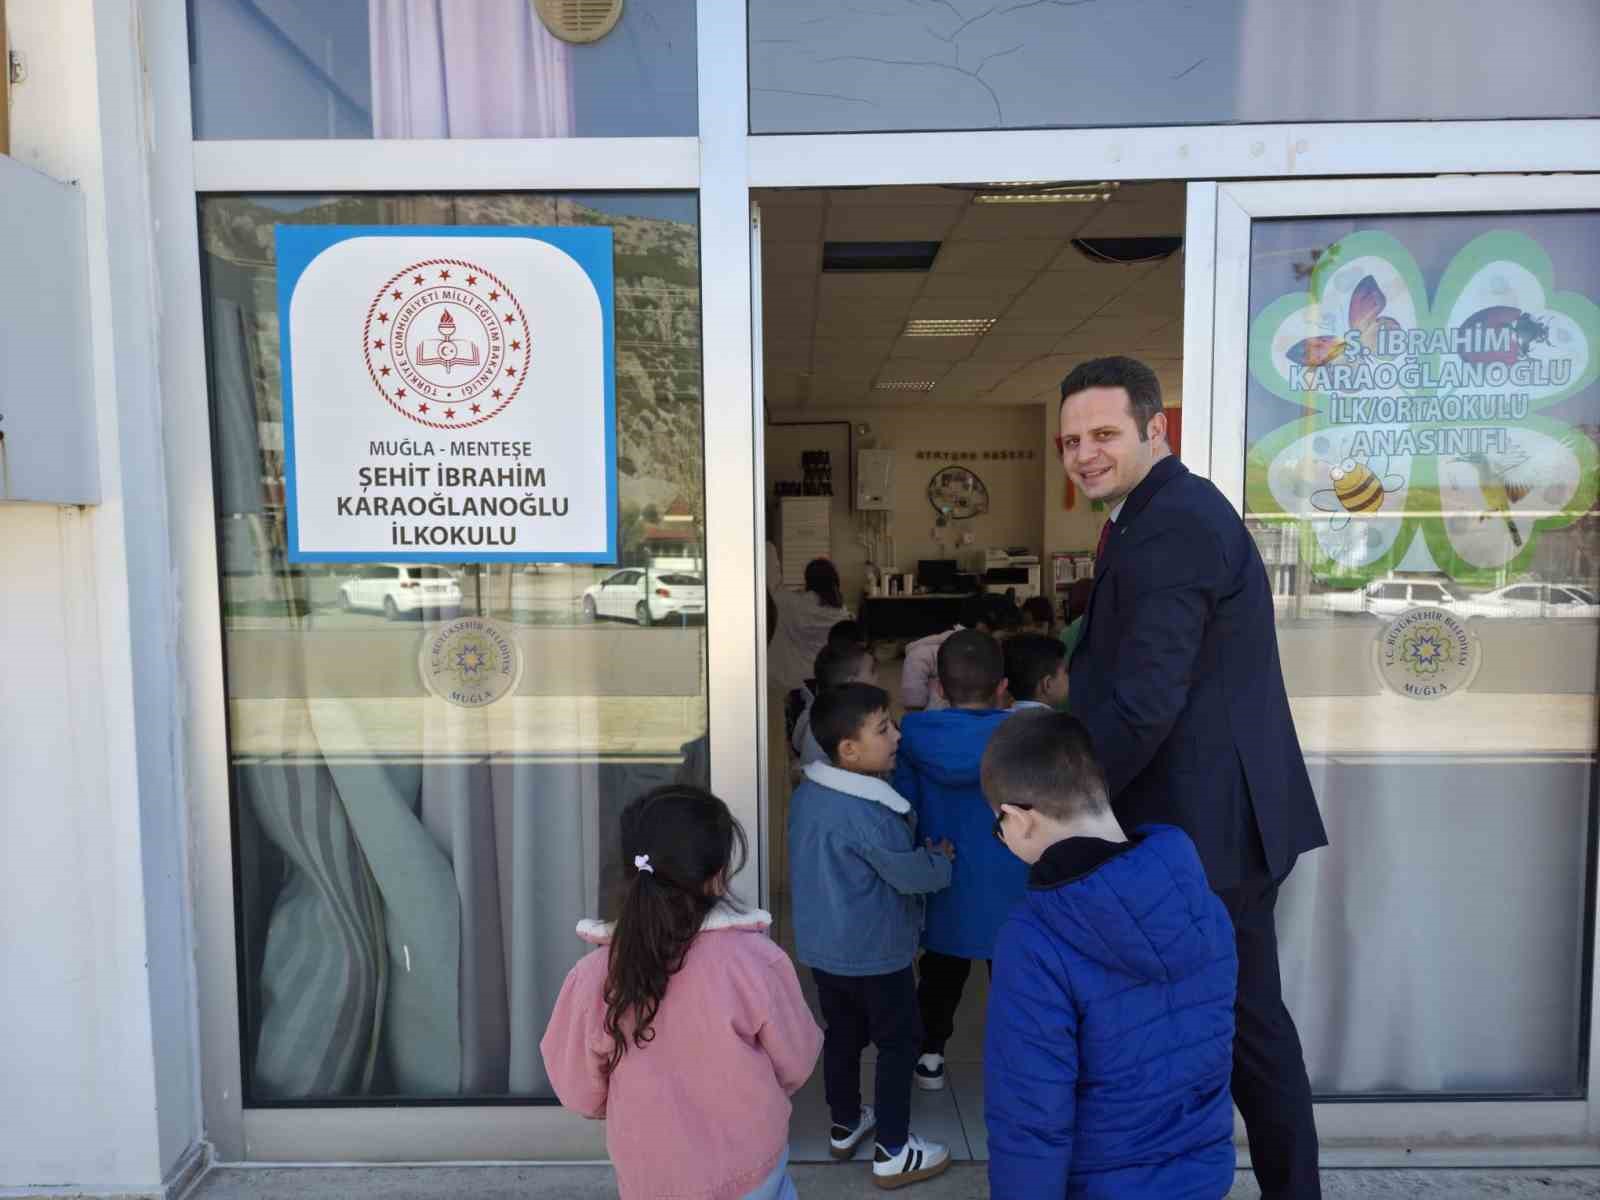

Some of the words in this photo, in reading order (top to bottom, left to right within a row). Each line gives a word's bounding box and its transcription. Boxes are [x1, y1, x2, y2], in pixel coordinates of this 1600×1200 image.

[394, 289, 439, 358] CUMHURİYETİ
[474, 304, 500, 343] EĞİTİM
[1343, 330, 1371, 363] Ş.
[1376, 326, 1511, 355] İBRAHİM
[399, 359, 437, 398] TÜRKİYE
[461, 345, 501, 397] BAKANLIĞI
[1288, 355, 1572, 391] KARAOĞLANOĞLU
[1329, 393, 1529, 424] İLK/ORTAOKULU
[369, 438, 435, 457] MUĞLA
[450, 441, 532, 460] MENTEŞE
[1350, 427, 1508, 458] ANASINIFI
[358, 462, 431, 493] ŞEHİT
[437, 462, 547, 488] İBRAHİM
[336, 491, 569, 517] KARAOĞLANOĞLU
[391, 521, 517, 546] İLKOKULU
